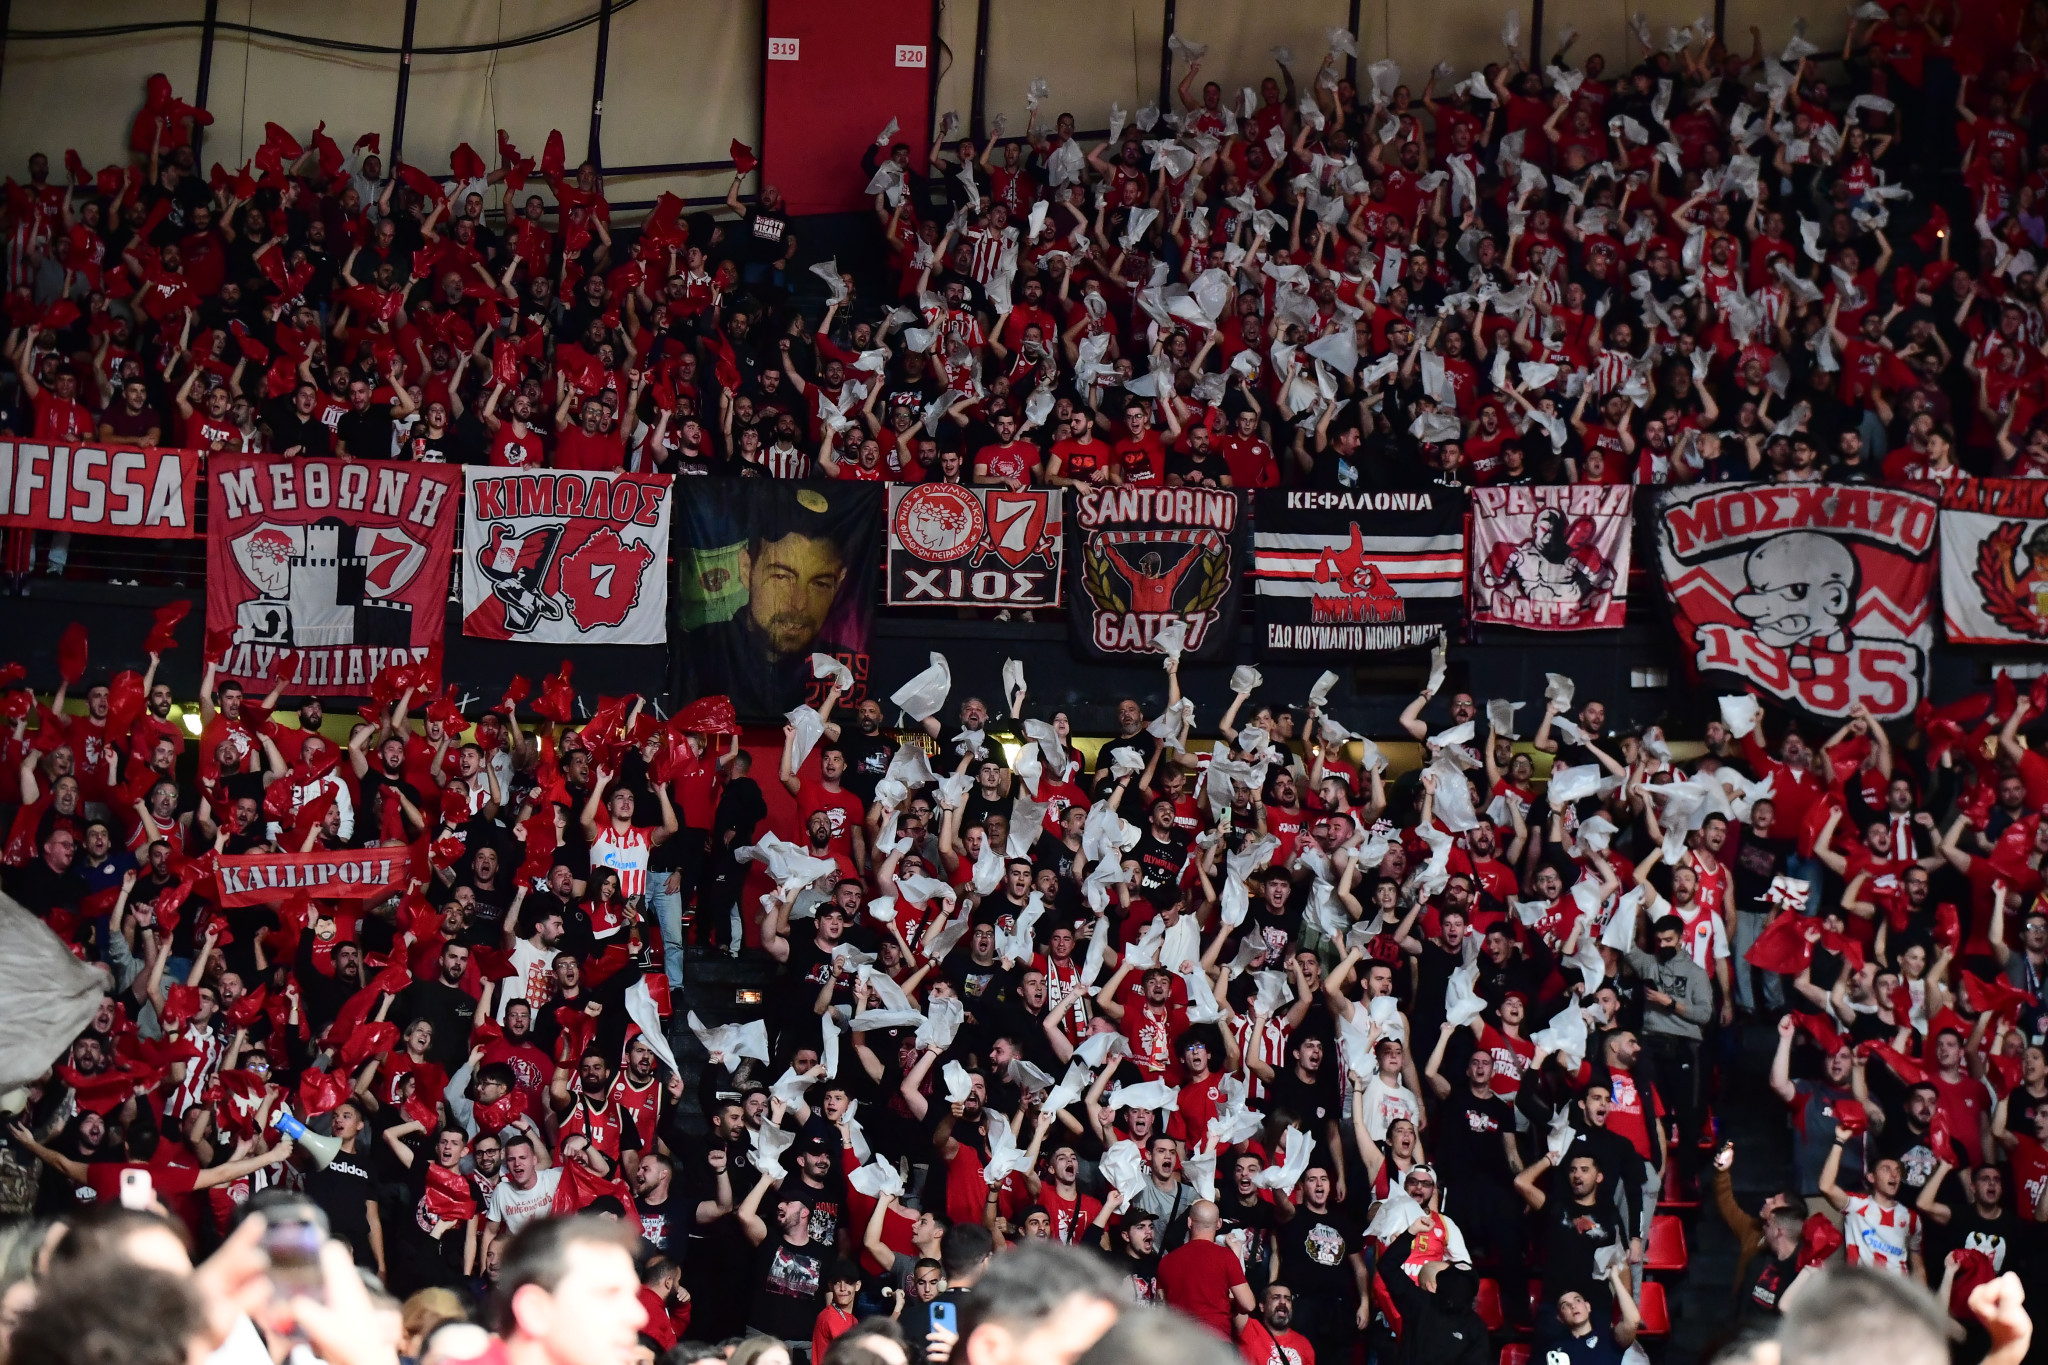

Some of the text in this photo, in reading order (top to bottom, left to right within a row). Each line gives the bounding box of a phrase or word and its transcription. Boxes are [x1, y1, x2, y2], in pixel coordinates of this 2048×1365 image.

[772, 42, 796, 55] 319
[899, 50, 923, 62] 320
[218, 463, 449, 528] ΜΕΘΩΝΗ
[473, 475, 666, 526] ΚΙΜΩΛΟΣ
[923, 484, 982, 530] ΟΛΥΜΠΙΑΚΟΣ
[1080, 487, 1234, 531] SANTORINI
[1286, 491, 1433, 511] ΚΕΦΑΛΟΝΙΑ
[1475, 485, 1632, 518] PATRA
[996, 498, 1037, 552] 7
[1665, 487, 1938, 553] ΜΟΣΧΑΤΟ
[366, 533, 412, 589] 7
[590, 563, 616, 598] 7
[904, 569, 1046, 601] ΧΙΟΣ
[1491, 590, 1581, 626] GATE
[1185, 612, 1206, 647] 7
[1268, 624, 1292, 648] ΕΔΩ
[1295, 626, 1362, 650] ΚΟΥΜΑΝΤΟ
[1365, 626, 1402, 650] ΜΟΝΟ
[1706, 628, 1909, 715] 1985
[220, 859, 392, 895] KALLIPOLI
[330, 1161, 369, 1179] adidas
